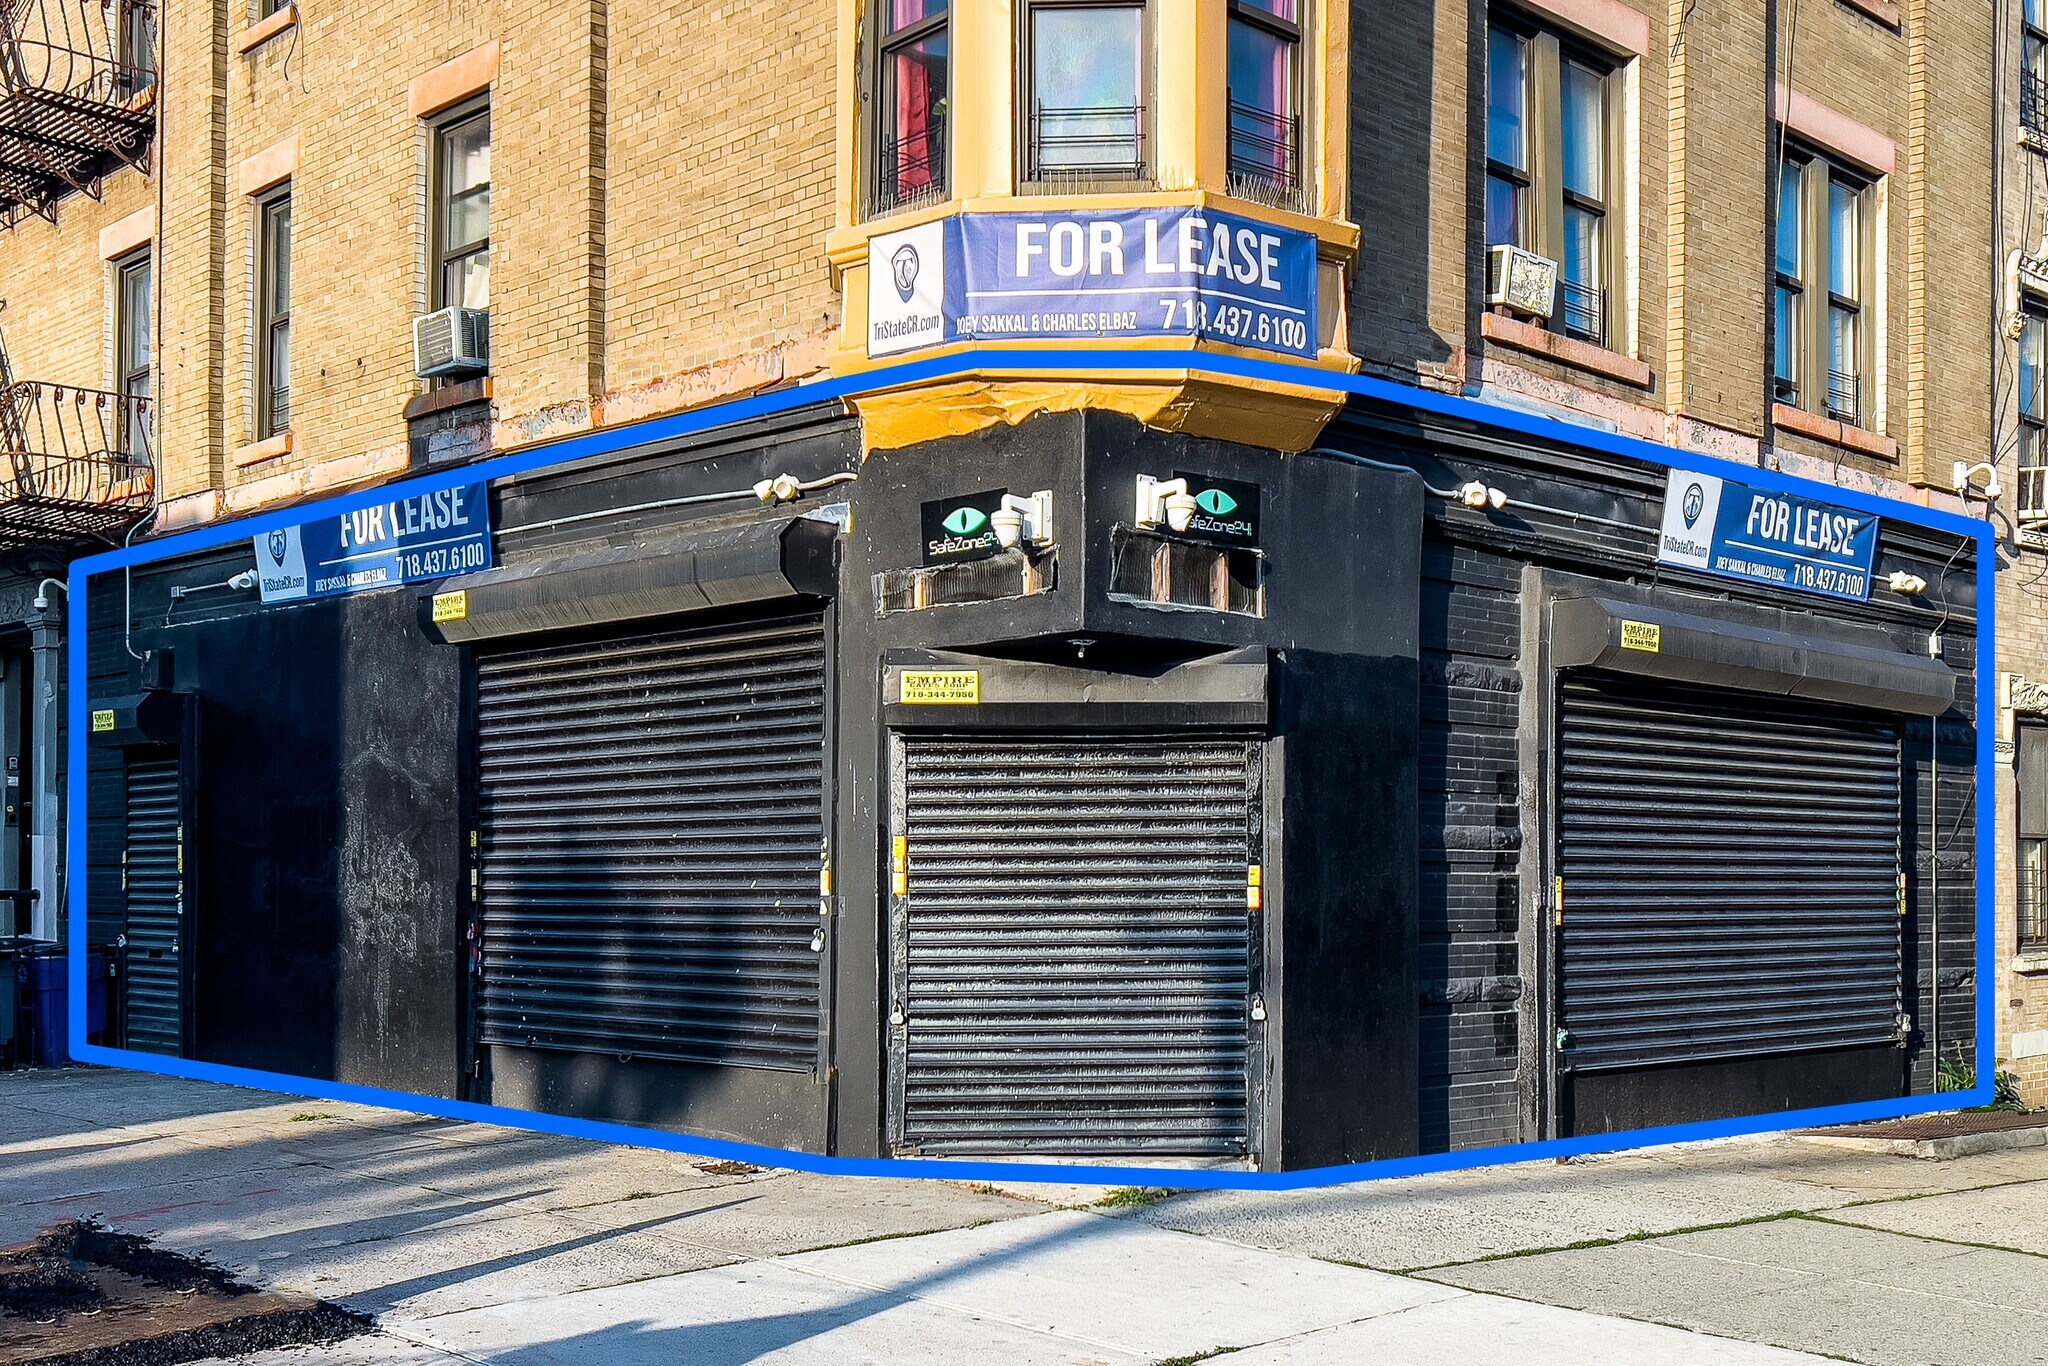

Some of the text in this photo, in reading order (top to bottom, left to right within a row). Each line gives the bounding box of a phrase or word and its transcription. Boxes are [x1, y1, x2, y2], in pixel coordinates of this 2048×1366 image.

[1016, 216, 1282, 291] FOR LEASE
[874, 313, 940, 341] TriStateCR.com
[956, 311, 1137, 335] JOEY SAKKAL & CHARLES ELBAZ
[1159, 298, 1307, 350] 718.437.6100
[340, 484, 469, 548] FOR LEASE
[1188, 514, 1250, 536] afeZone24
[1746, 494, 1860, 556] FOR LEASE
[395, 541, 485, 579] 718.437.6100
[1663, 535, 1708, 559] TriStateCR.com
[1715, 555, 1730, 570] JOEY
[262, 575, 304, 593] TriStateCR.com
[1793, 563, 1865, 597] 718.437.6100
[1624, 624, 1658, 636] EMPIRE
[906, 676, 975, 684] EMPIRE
